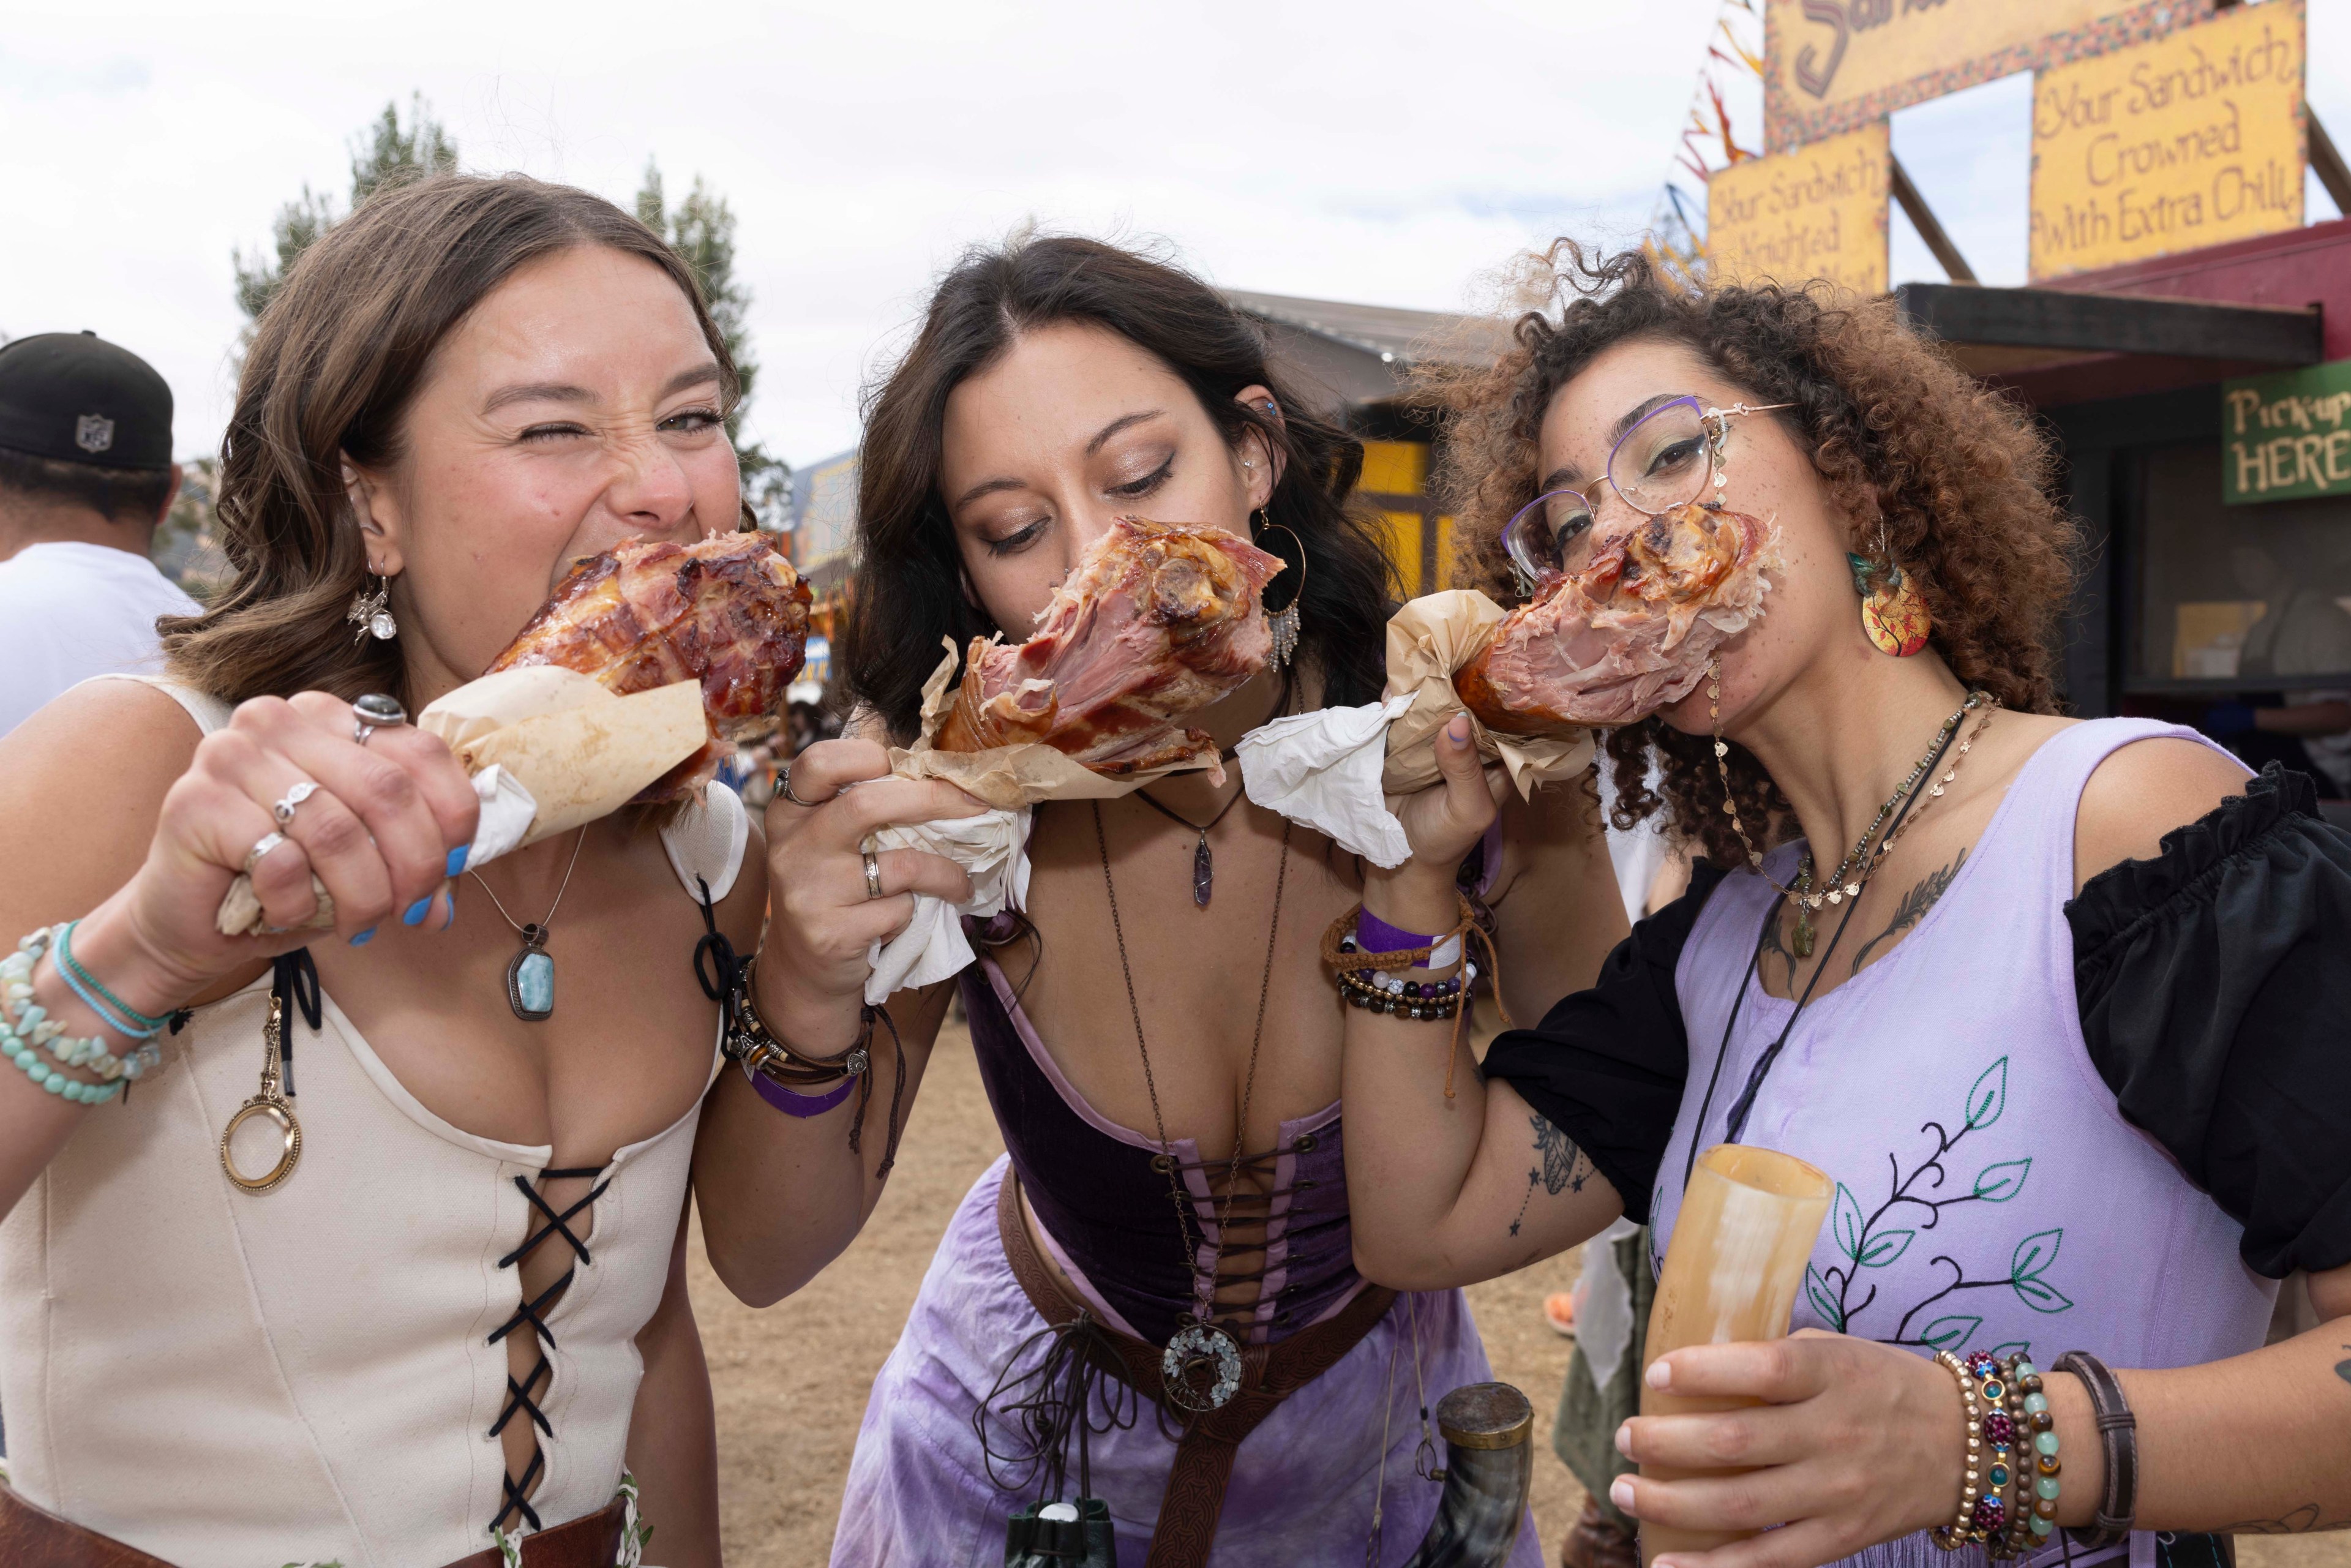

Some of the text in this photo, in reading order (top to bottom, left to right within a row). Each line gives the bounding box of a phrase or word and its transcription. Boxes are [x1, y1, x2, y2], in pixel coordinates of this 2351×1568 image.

[2034, 23, 2297, 140] Your Sandwich
[2085, 98, 2241, 187] Crowned
[1767, 144, 1882, 214] Sandwich
[2117, 187, 2203, 242] Extra
[2230, 429, 2351, 493] HERE
